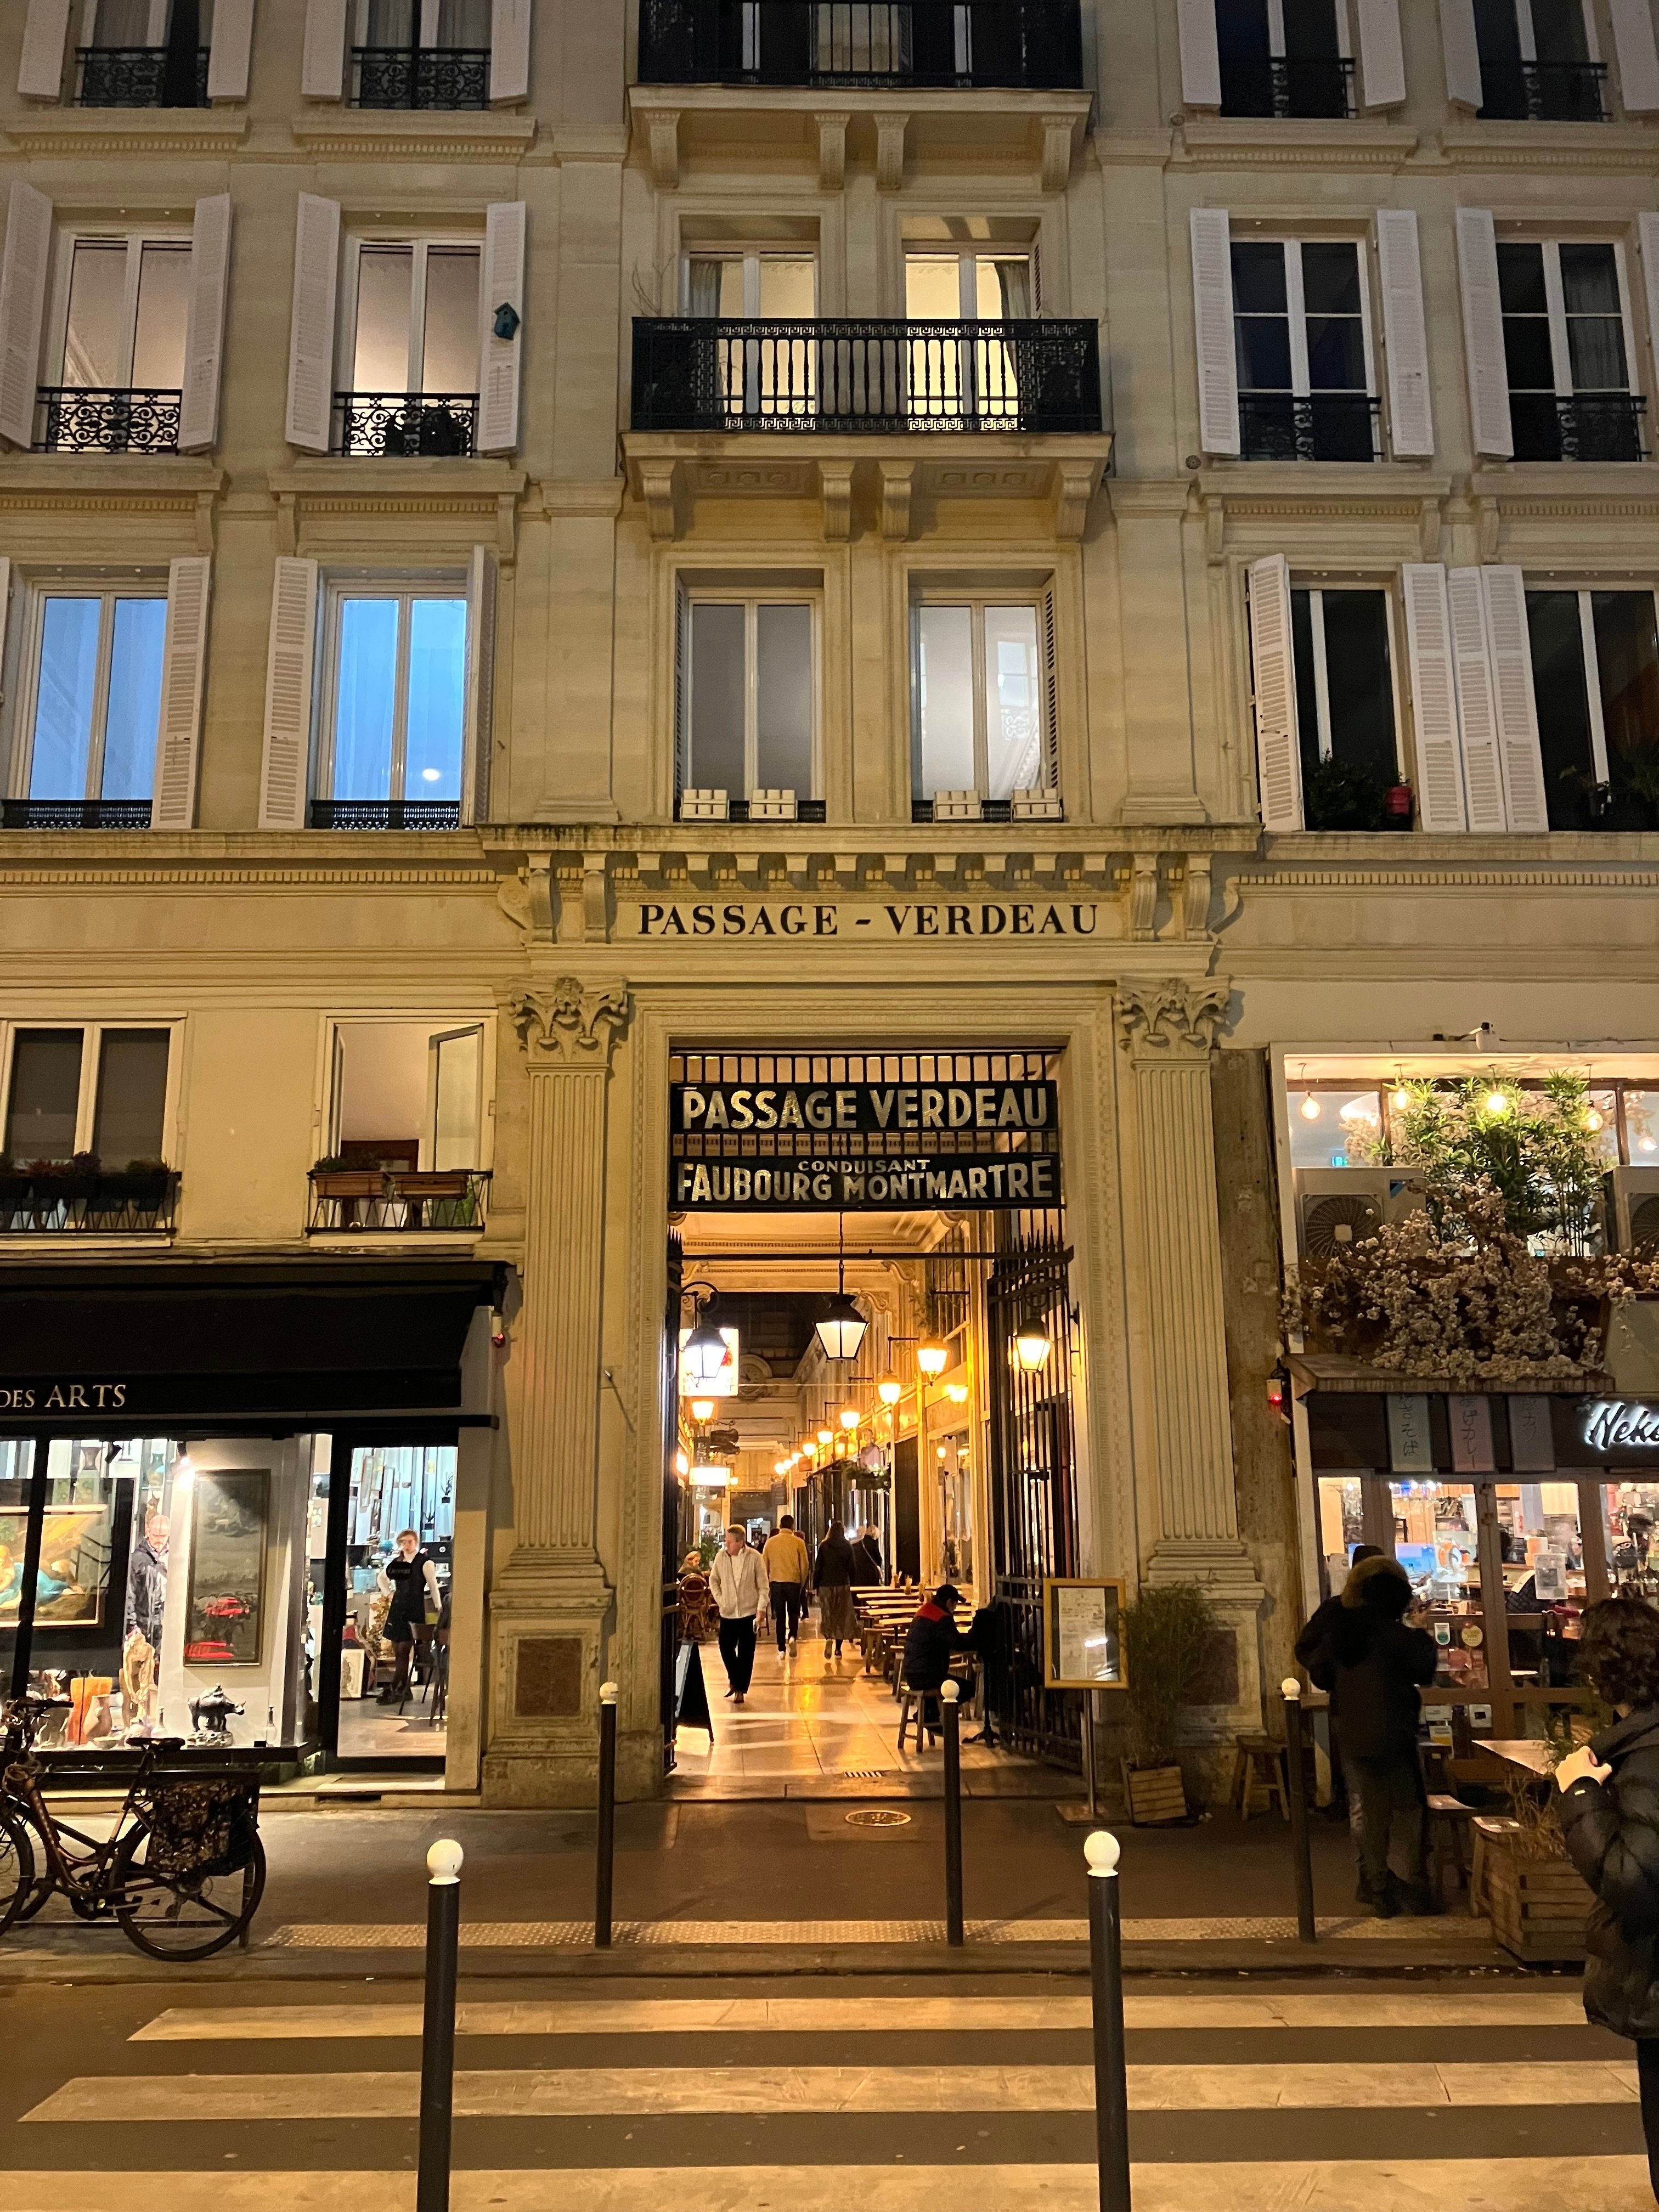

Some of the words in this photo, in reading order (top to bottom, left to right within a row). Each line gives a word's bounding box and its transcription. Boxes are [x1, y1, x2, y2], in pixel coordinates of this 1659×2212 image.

[638, 904, 838, 935] PASSAGE
[883, 904, 1098, 935] VERDEAU
[682, 1090, 857, 1129] PASSAGE
[868, 1087, 1048, 1128] VERDEAU
[677, 1162, 832, 1201] FAUBOURG
[843, 1159, 1053, 1201] MONTMARTRE
[798, 1159, 930, 1174] CONDUISANT
[44, 1384, 126, 1408] ARTS
